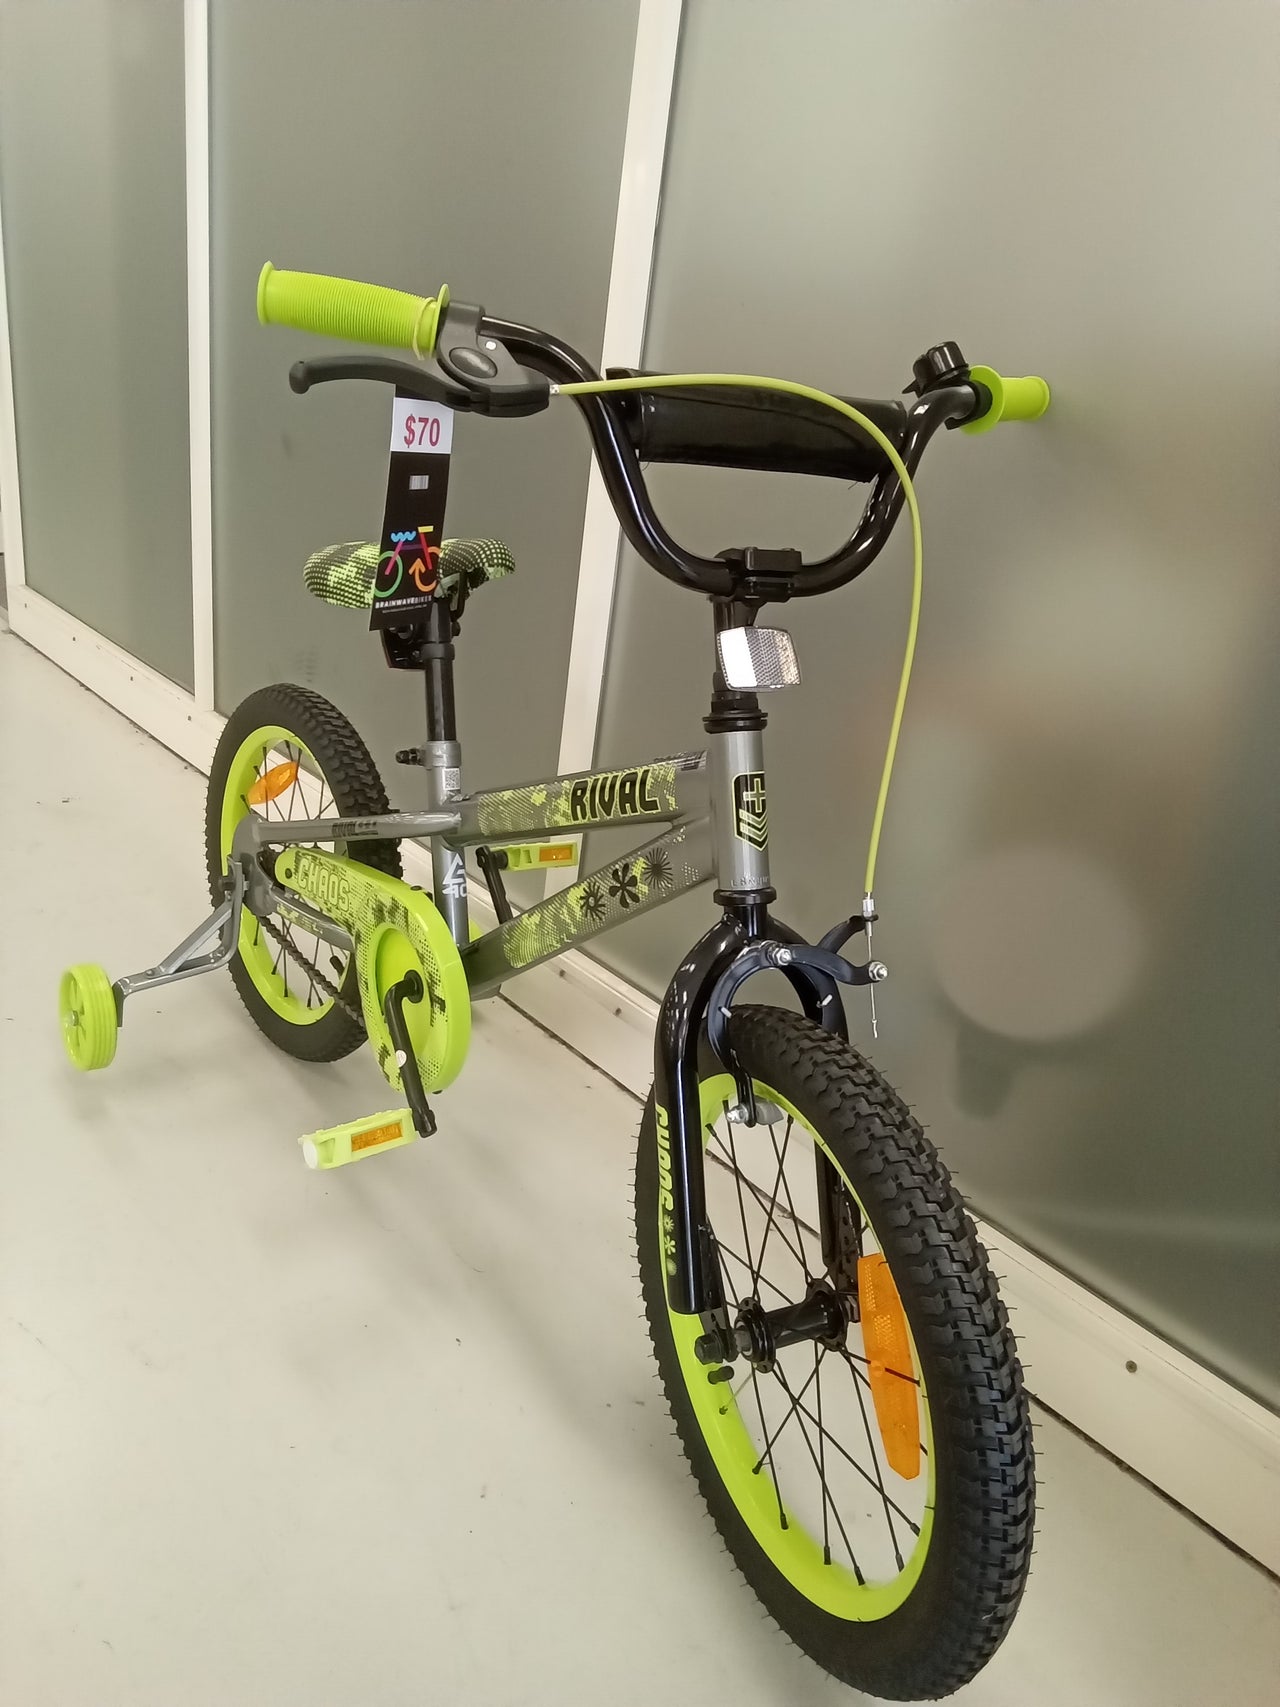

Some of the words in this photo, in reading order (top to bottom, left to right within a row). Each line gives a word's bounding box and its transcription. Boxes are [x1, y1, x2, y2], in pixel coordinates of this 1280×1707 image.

[404, 414, 440, 448] $70
[571, 768, 660, 822] RIVAL
[298, 857, 350, 912] CHAOS
